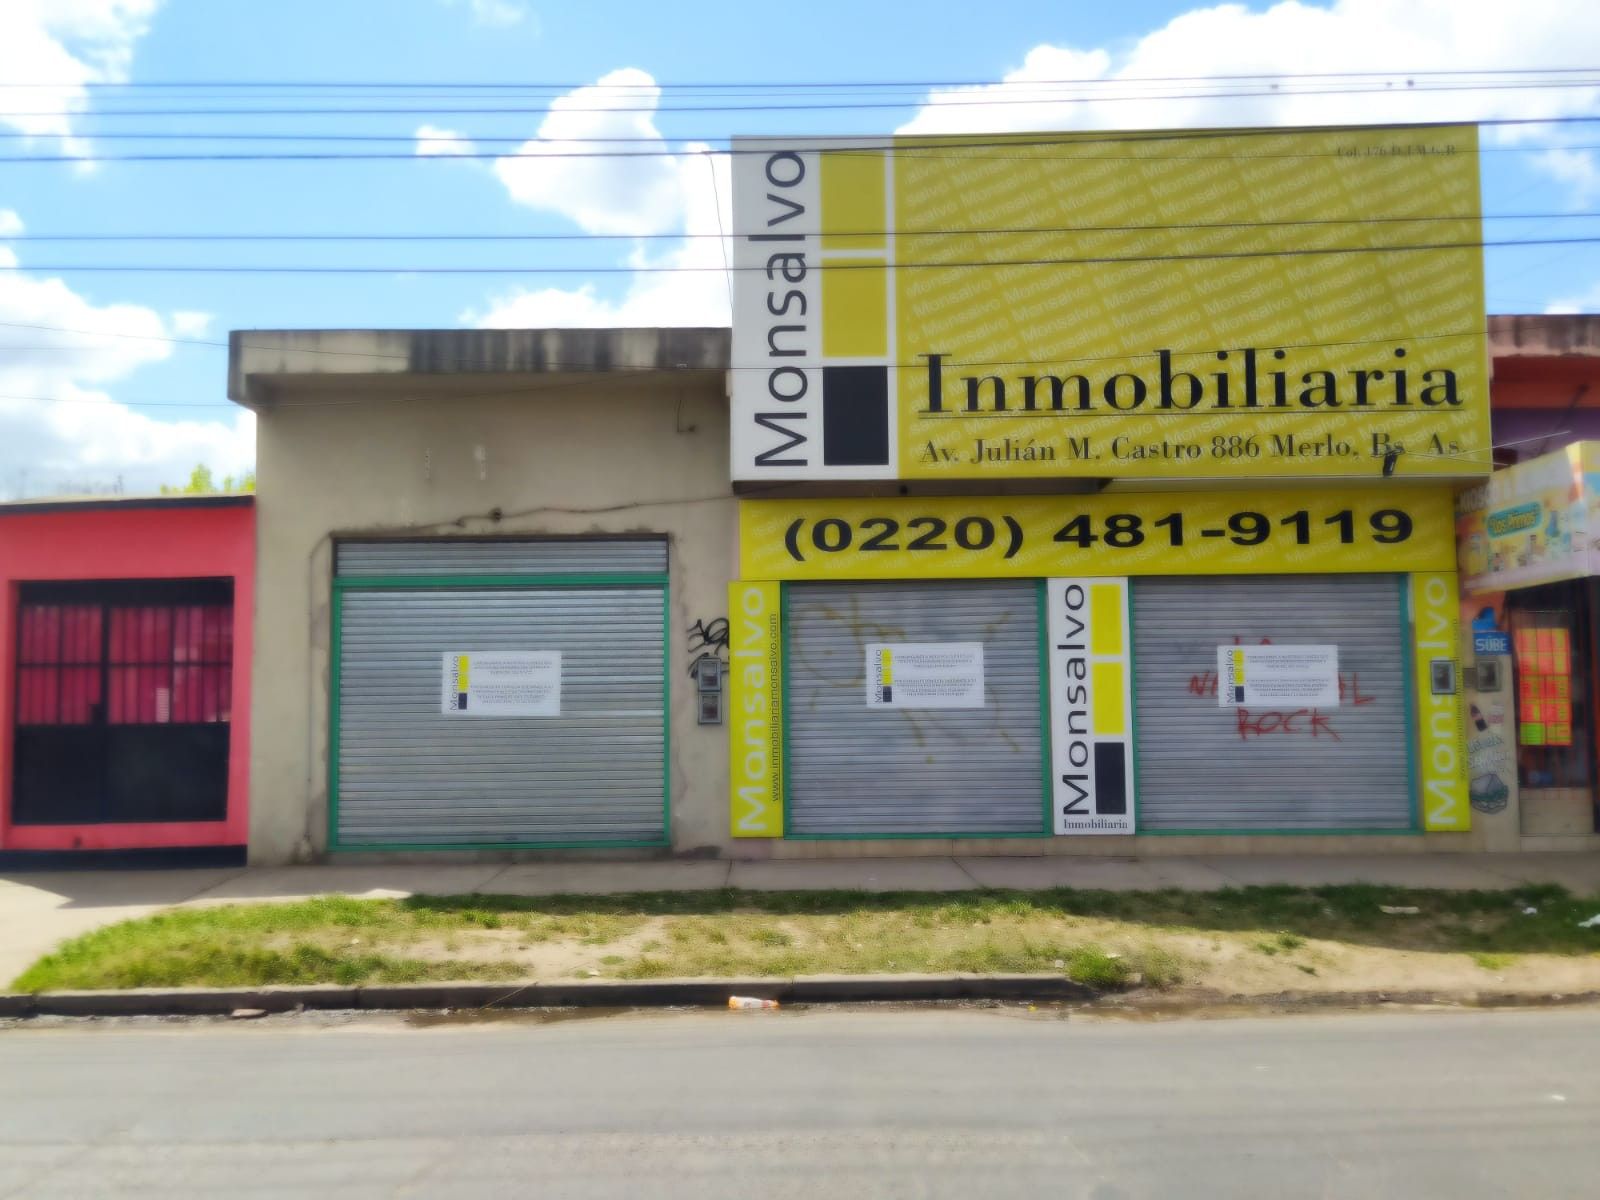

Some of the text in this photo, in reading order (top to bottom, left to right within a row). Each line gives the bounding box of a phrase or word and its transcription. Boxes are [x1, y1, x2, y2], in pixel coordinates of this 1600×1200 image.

[747, 149, 809, 467] Monsalvo
[918, 350, 1463, 413] Inmobiliaria
[920, 440, 961, 463] Av.
[970, 438, 1057, 464] Julián
[1066, 436, 1101, 460] M.
[1111, 436, 1201, 460] Castro
[1211, 435, 1260, 458] 886
[1270, 433, 1360, 458] Merlo,
[784, 508, 1414, 562] (0220) 481-9119
[450, 655, 460, 711] Monsalvo
[874, 649, 882, 704] Monsalvo
[1056, 583, 1091, 816] Monsalvo
[1226, 648, 1234, 704] Monsalvo
[736, 586, 768, 833] Monsalvo
[1237, 708, 1342, 742] ROCK
[1063, 818, 1129, 831] Inmobiliaria
